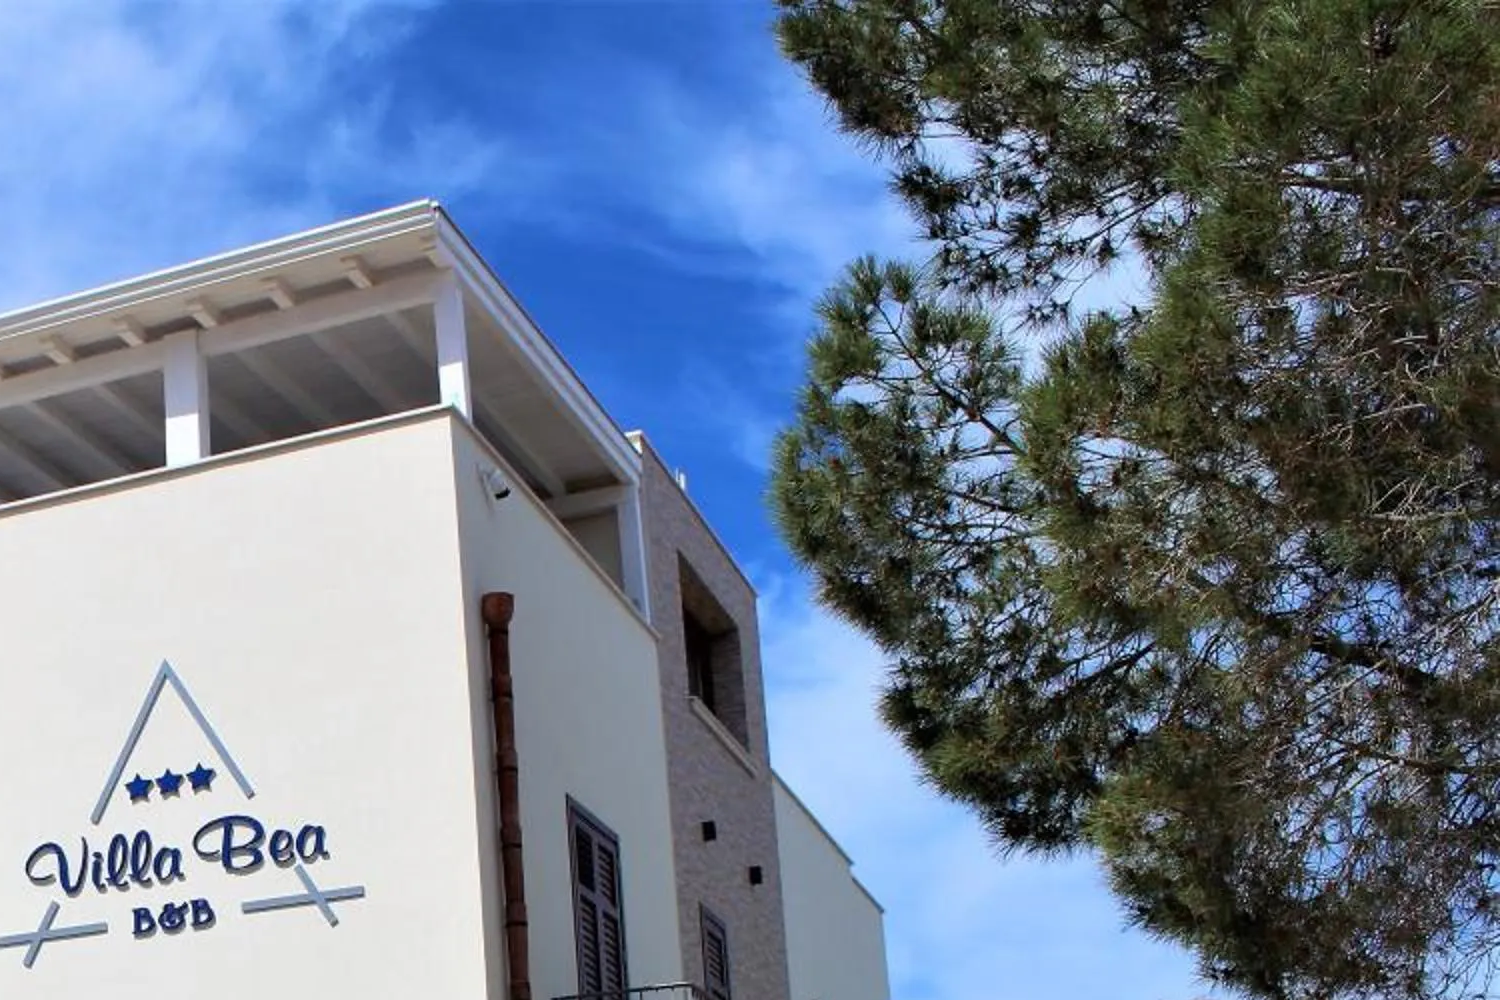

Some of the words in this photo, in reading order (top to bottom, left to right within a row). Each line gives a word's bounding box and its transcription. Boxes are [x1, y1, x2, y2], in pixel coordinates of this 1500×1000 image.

[25, 830, 184, 895] Villa
[193, 815, 328, 873] Bea
[132, 899, 215, 937] B&B
